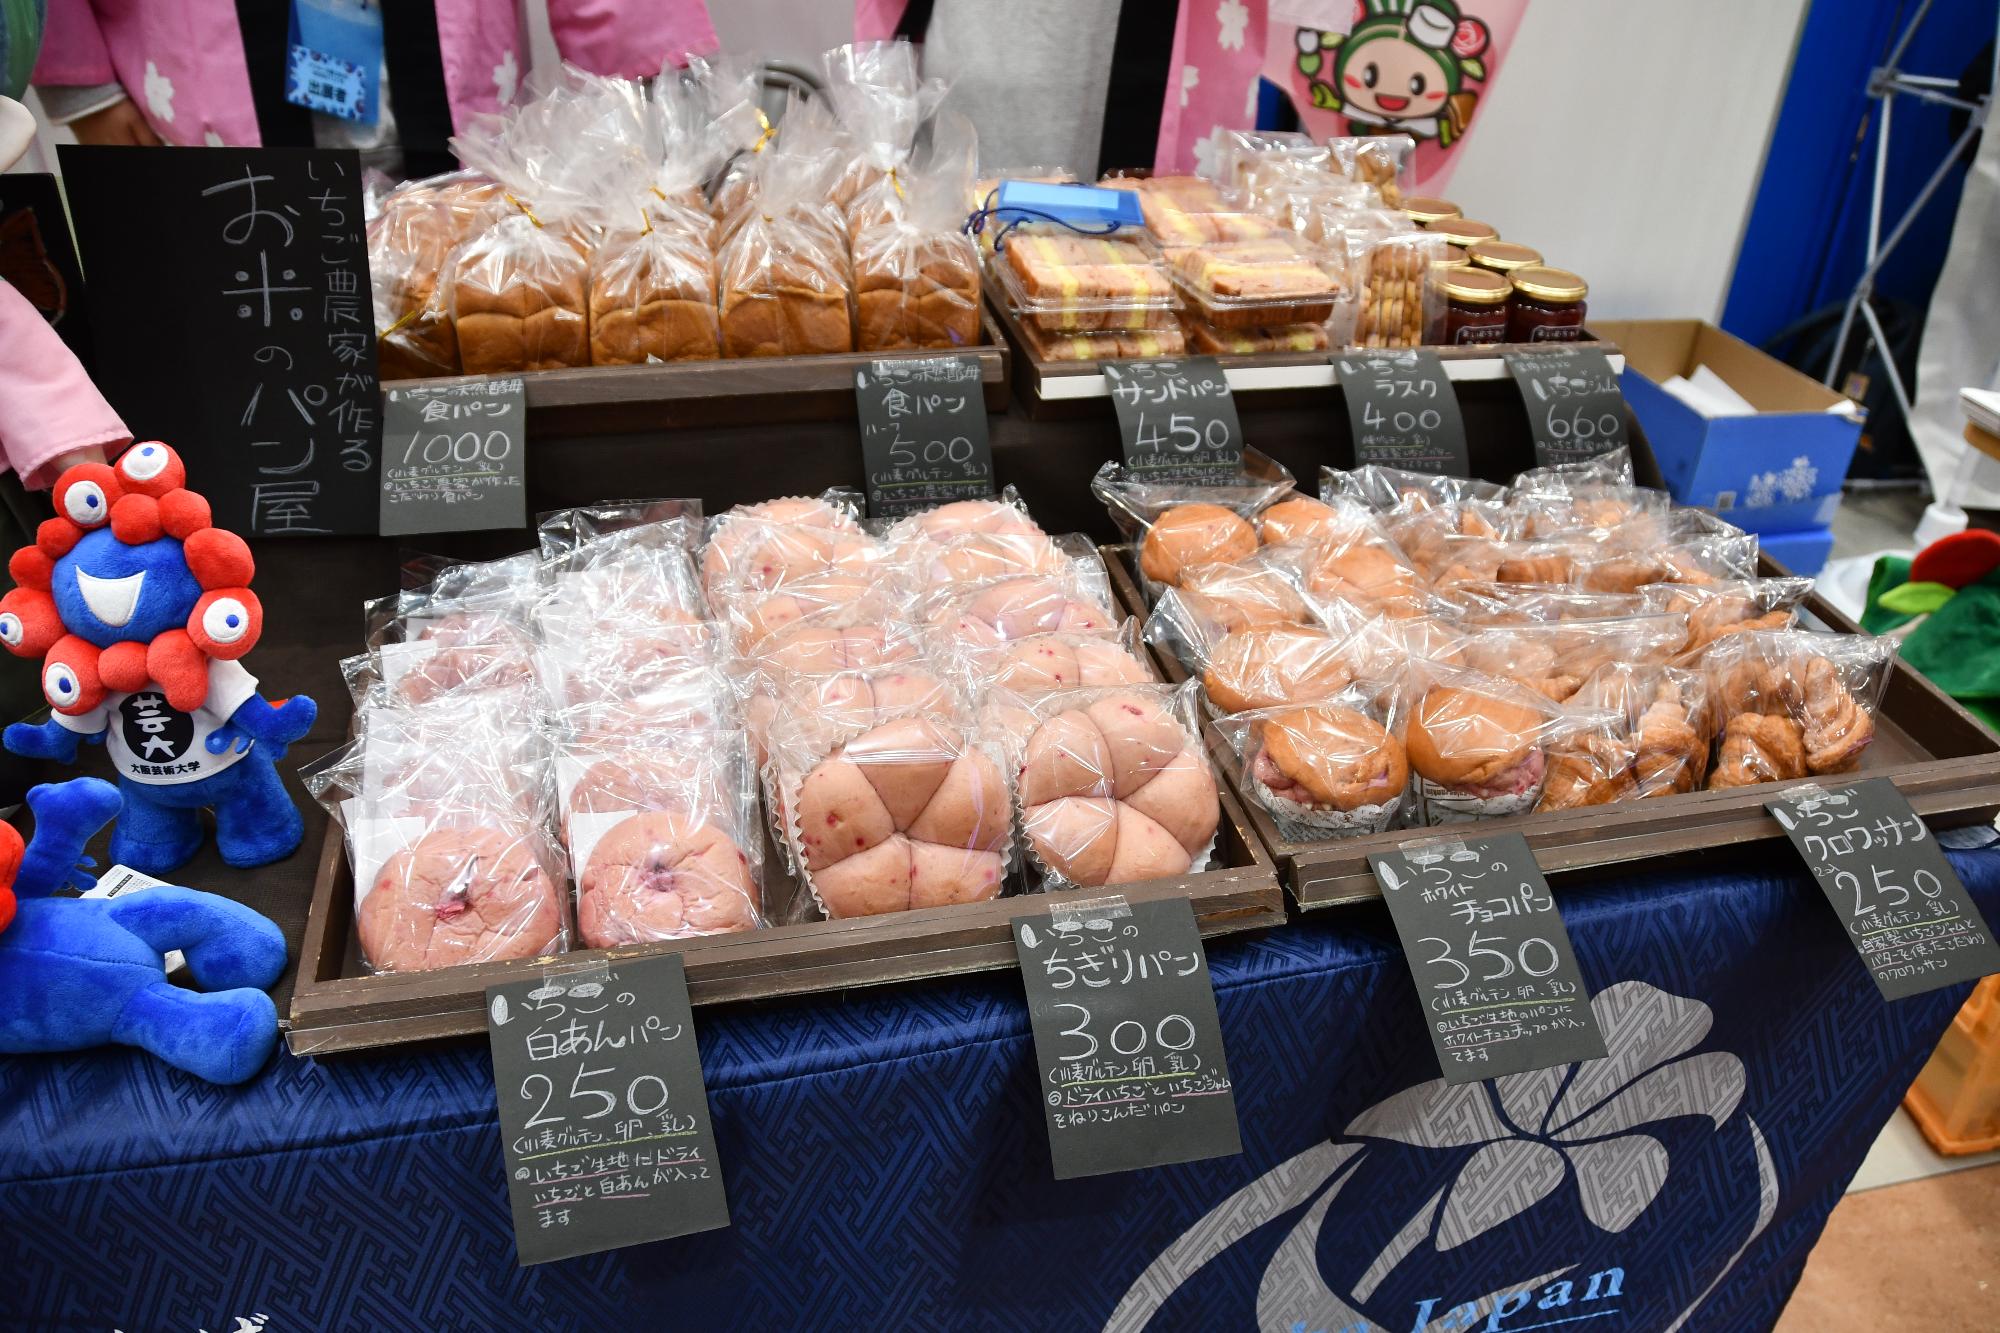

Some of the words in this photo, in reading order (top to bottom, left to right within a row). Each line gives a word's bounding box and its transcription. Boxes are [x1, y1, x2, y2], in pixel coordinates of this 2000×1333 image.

[306, 159, 374, 471] いちご農家が作る
[202, 164, 332, 534] お米のパン屋
[881, 388, 966, 418] 食パン
[1113, 376, 1232, 405] サンドパン
[1375, 379, 1438, 398] ラスク
[420, 400, 512, 422] 食パン
[1135, 411, 1230, 453] 450
[1363, 401, 1442, 430] 400
[1547, 403, 1619, 438] 660
[403, 430, 511, 464] 1000
[889, 434, 974, 466] 500
[130, 760, 201, 776] 大阪芸術大学
[1773, 788, 1859, 832] いちご
[1804, 813, 1927, 861] クロワッサン
[1378, 845, 1508, 891] いちごの
[1420, 883, 1474, 903] ホワイト
[1450, 882, 1553, 925] チョコパン
[1835, 864, 1942, 916] 250
[1042, 944, 1199, 989] ちぎりパン
[1417, 930, 1560, 989] 350
[1878, 958, 1948, 982] のクロワッサン
[526, 1015, 682, 1061] 白あんパン
[1053, 1003, 1196, 1061] 300
[1451, 1048, 1489, 1062] てます
[520, 1062, 669, 1131] 250
[538, 1209, 572, 1229] ます
[1409, 1266, 1625, 1333] Japan
